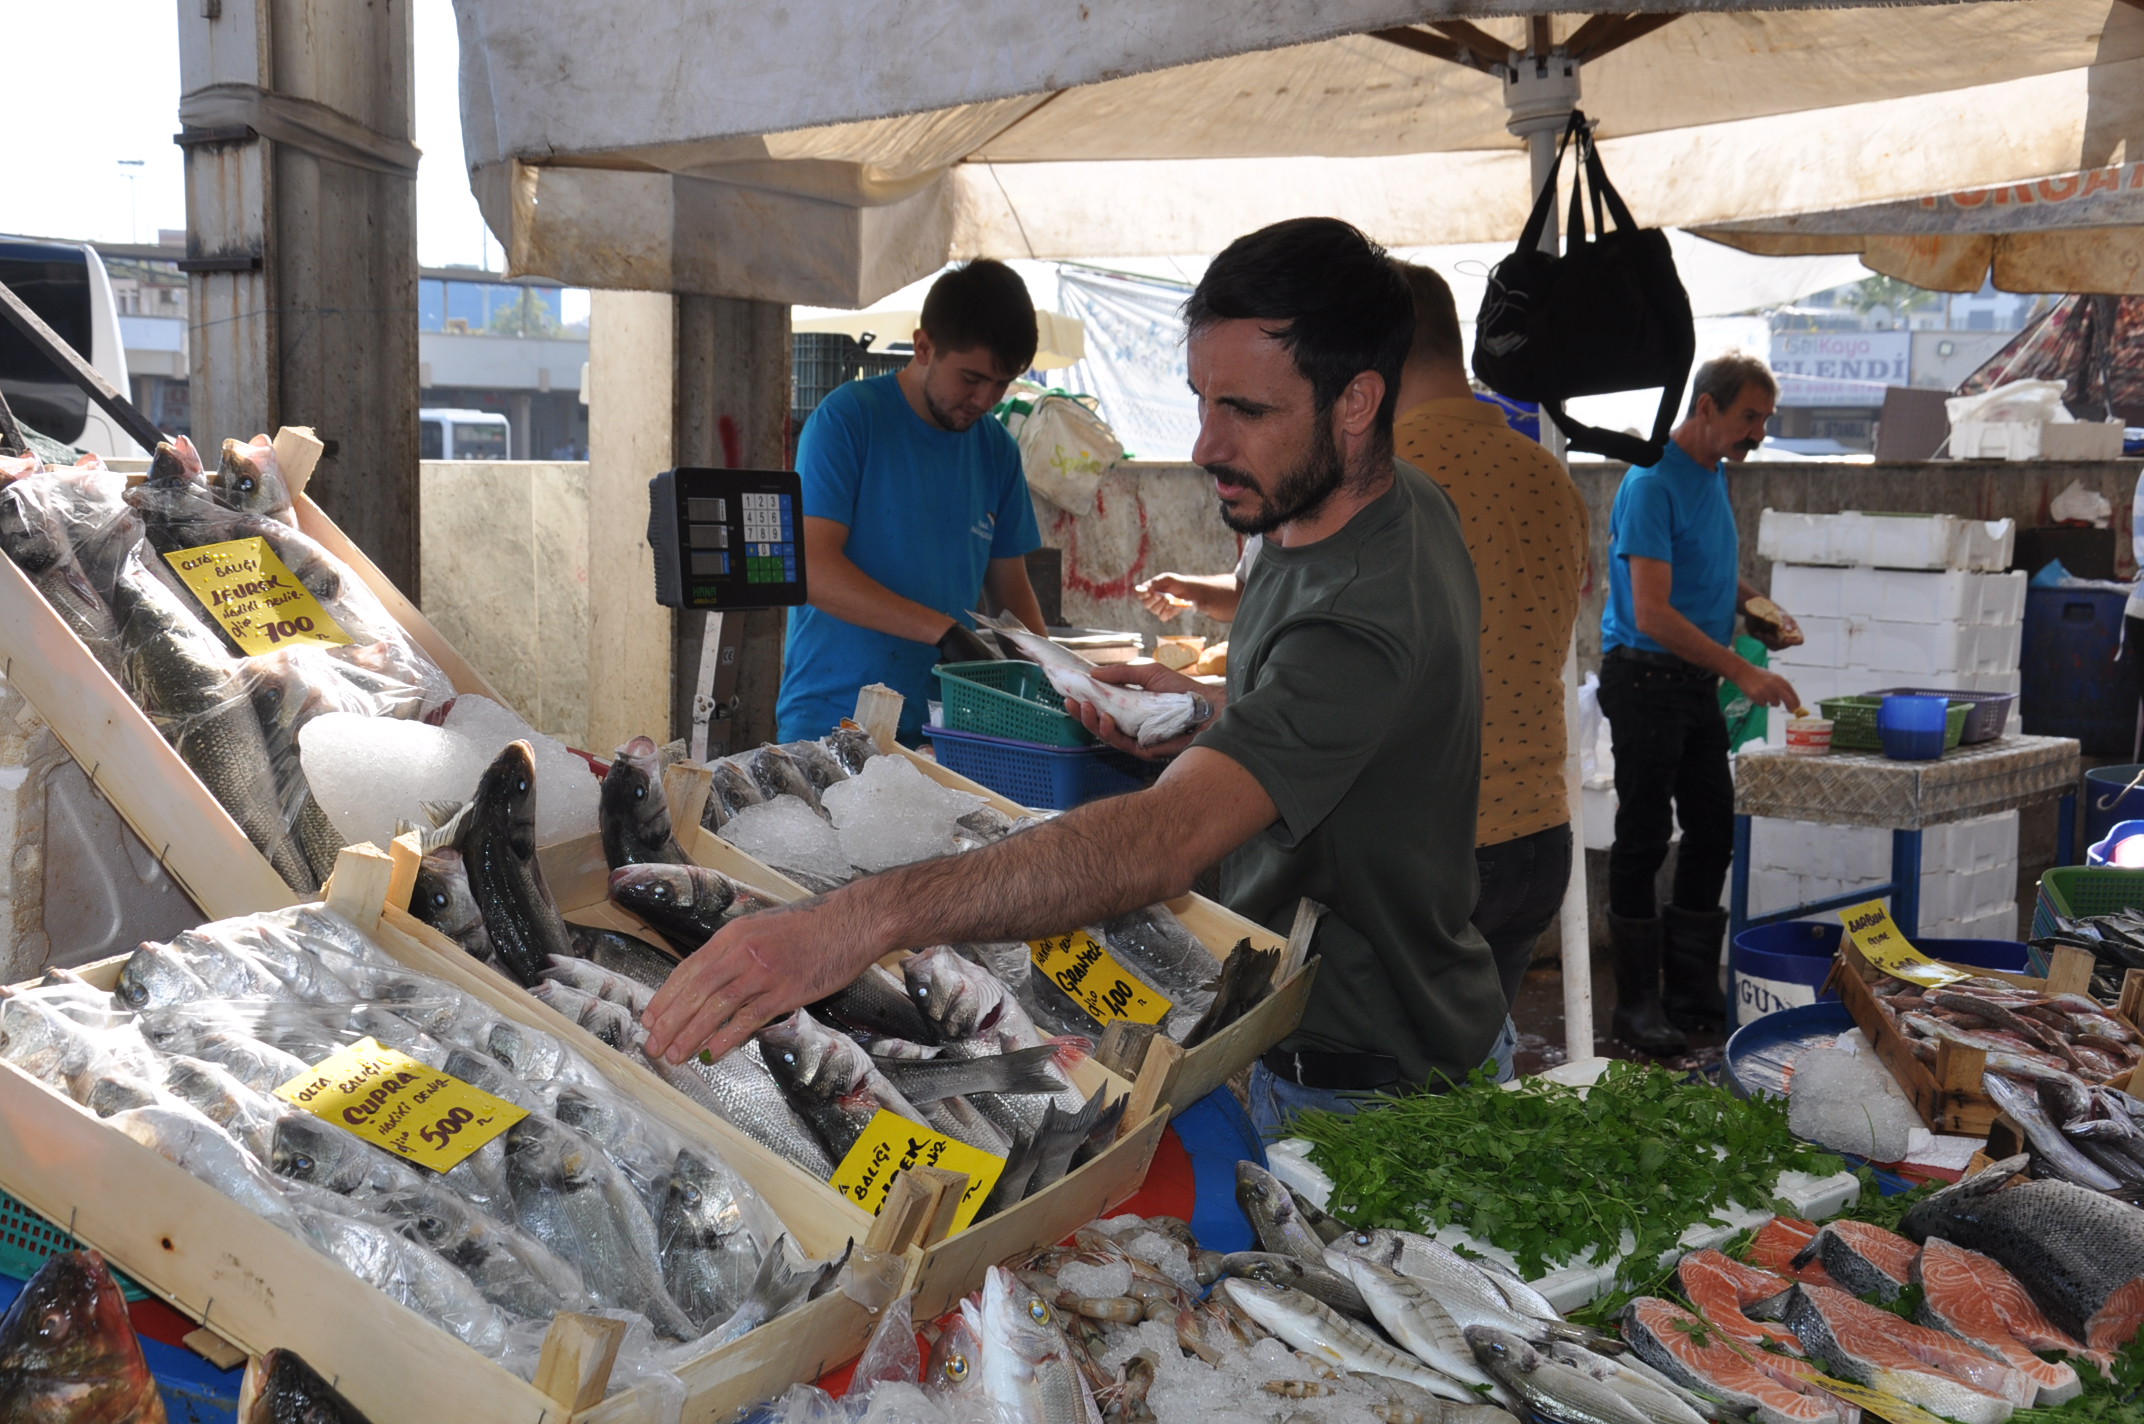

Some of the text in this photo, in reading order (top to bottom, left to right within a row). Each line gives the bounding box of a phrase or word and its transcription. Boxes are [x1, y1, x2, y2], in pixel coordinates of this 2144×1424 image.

[181, 554, 213, 571] OLTA
[255, 615, 315, 644] 700
[1102, 979, 1134, 1018] 400
[298, 1077, 332, 1102] OLTA
[419, 1107, 475, 1151] 500
[854, 1142, 891, 1201] BALIĞI
